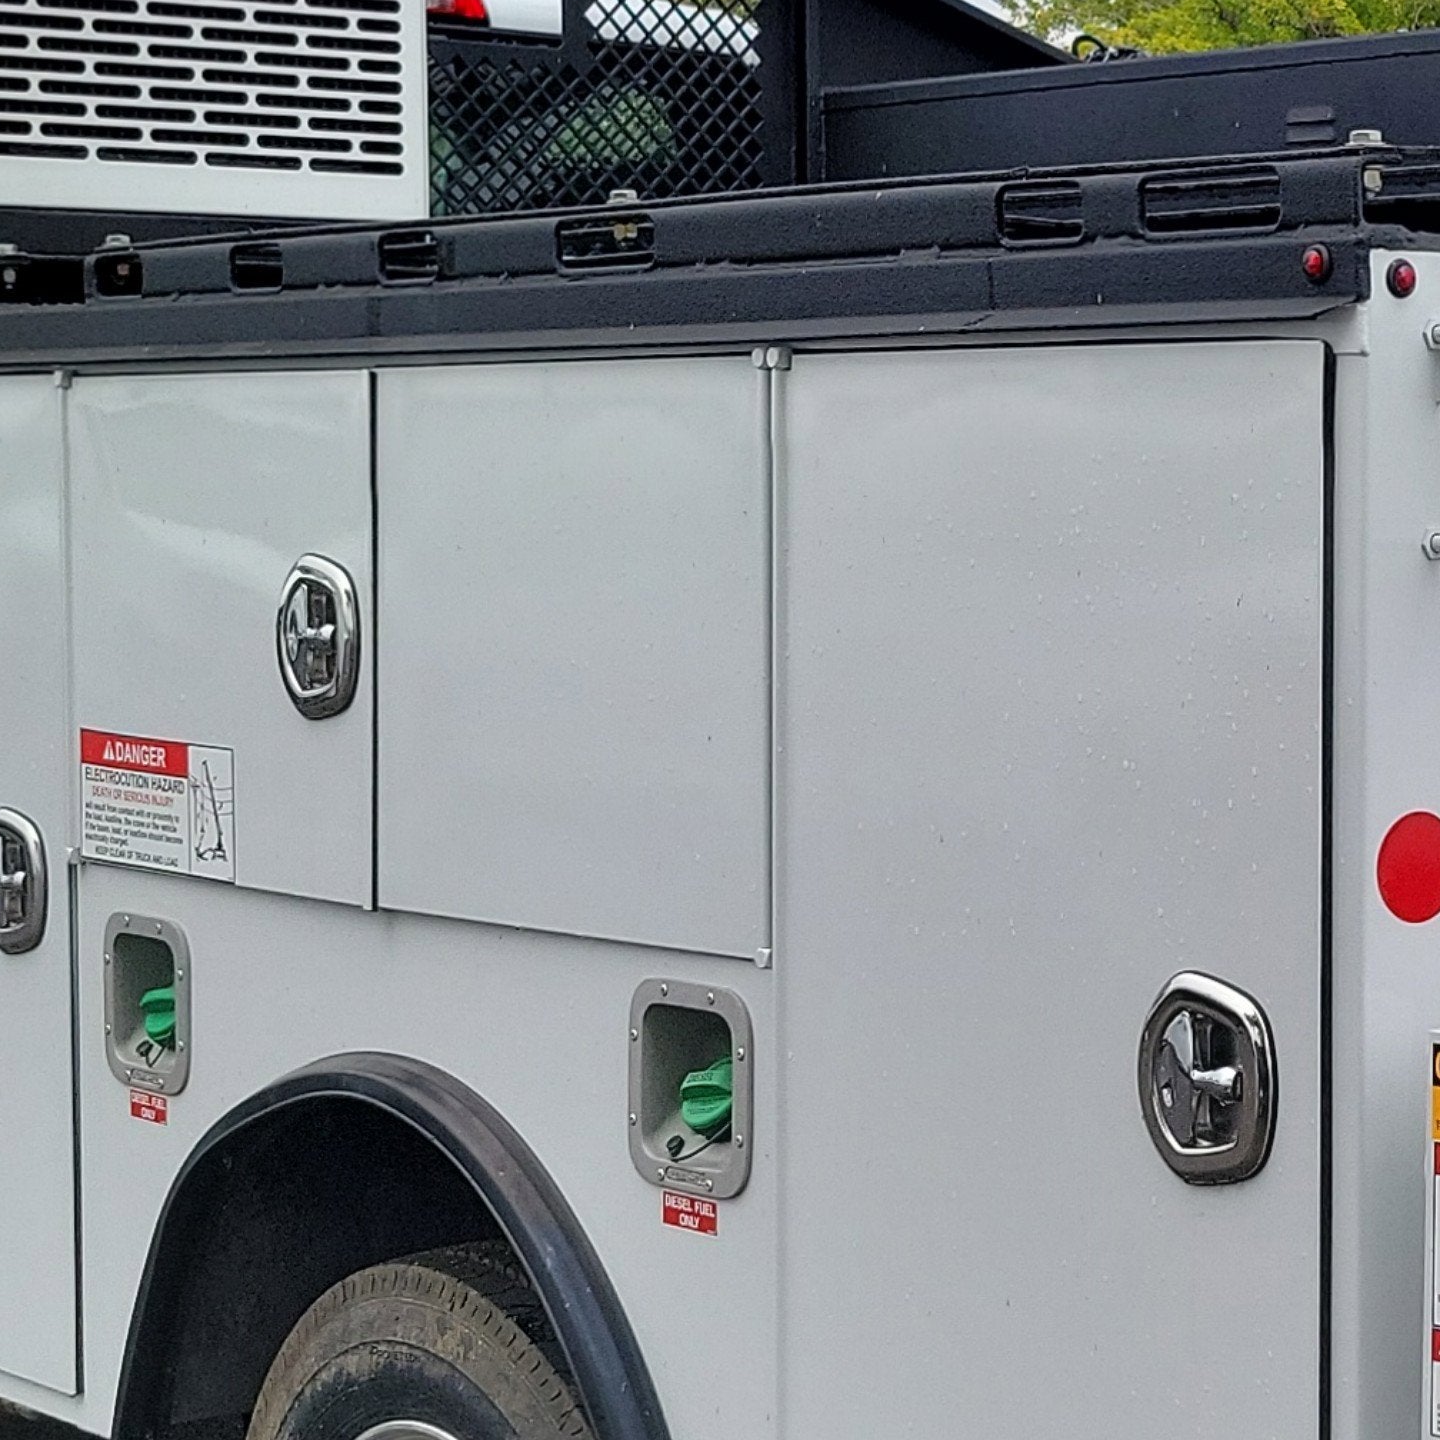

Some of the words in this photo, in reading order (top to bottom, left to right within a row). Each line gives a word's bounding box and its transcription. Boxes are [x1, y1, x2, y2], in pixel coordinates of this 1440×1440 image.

[114, 740, 167, 768] DANGER
[85, 766, 149, 789] ELECTROCUTION
[151, 778, 185, 795] HAZARD
[665, 1193, 693, 1212] DIESEL
[694, 1201, 715, 1218] FUEL
[679, 1213, 700, 1228] ONLY
